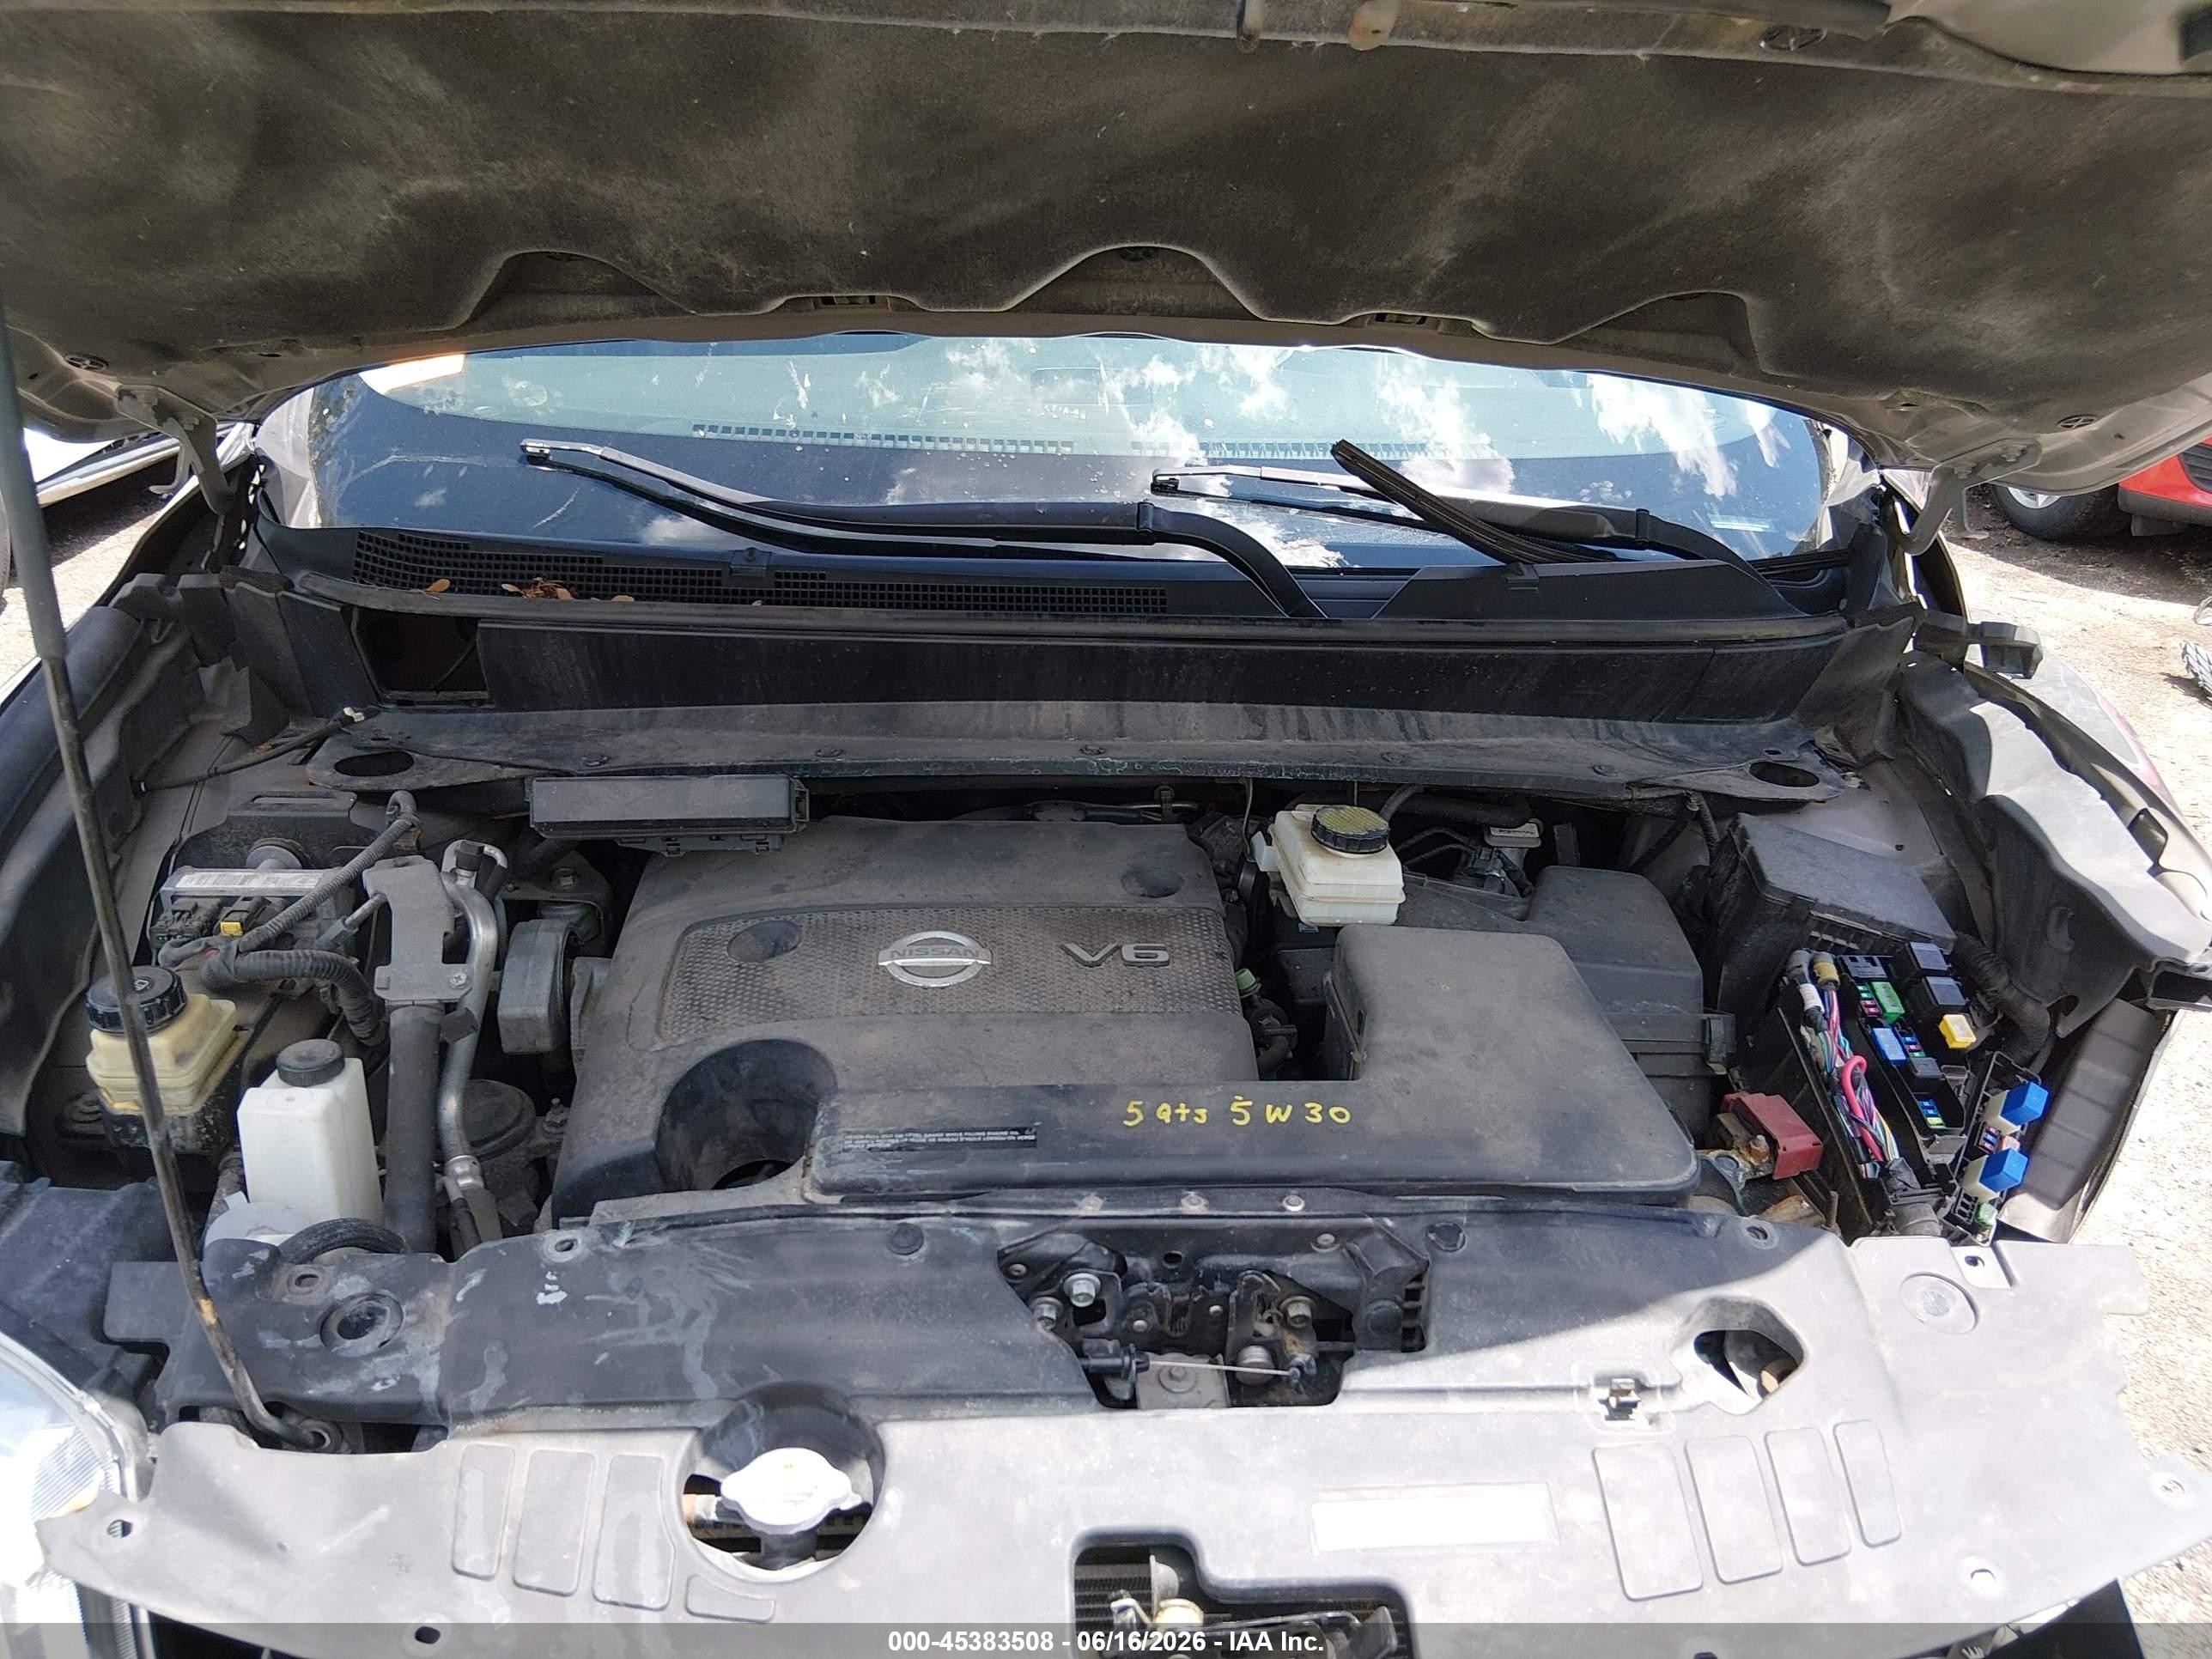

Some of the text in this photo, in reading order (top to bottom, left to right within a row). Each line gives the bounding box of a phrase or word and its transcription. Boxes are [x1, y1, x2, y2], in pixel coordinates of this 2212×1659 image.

[890, 947, 980, 958] NISSAN
[1061, 943, 1170, 966] V6
[1122, 1100, 1145, 1127] 5
